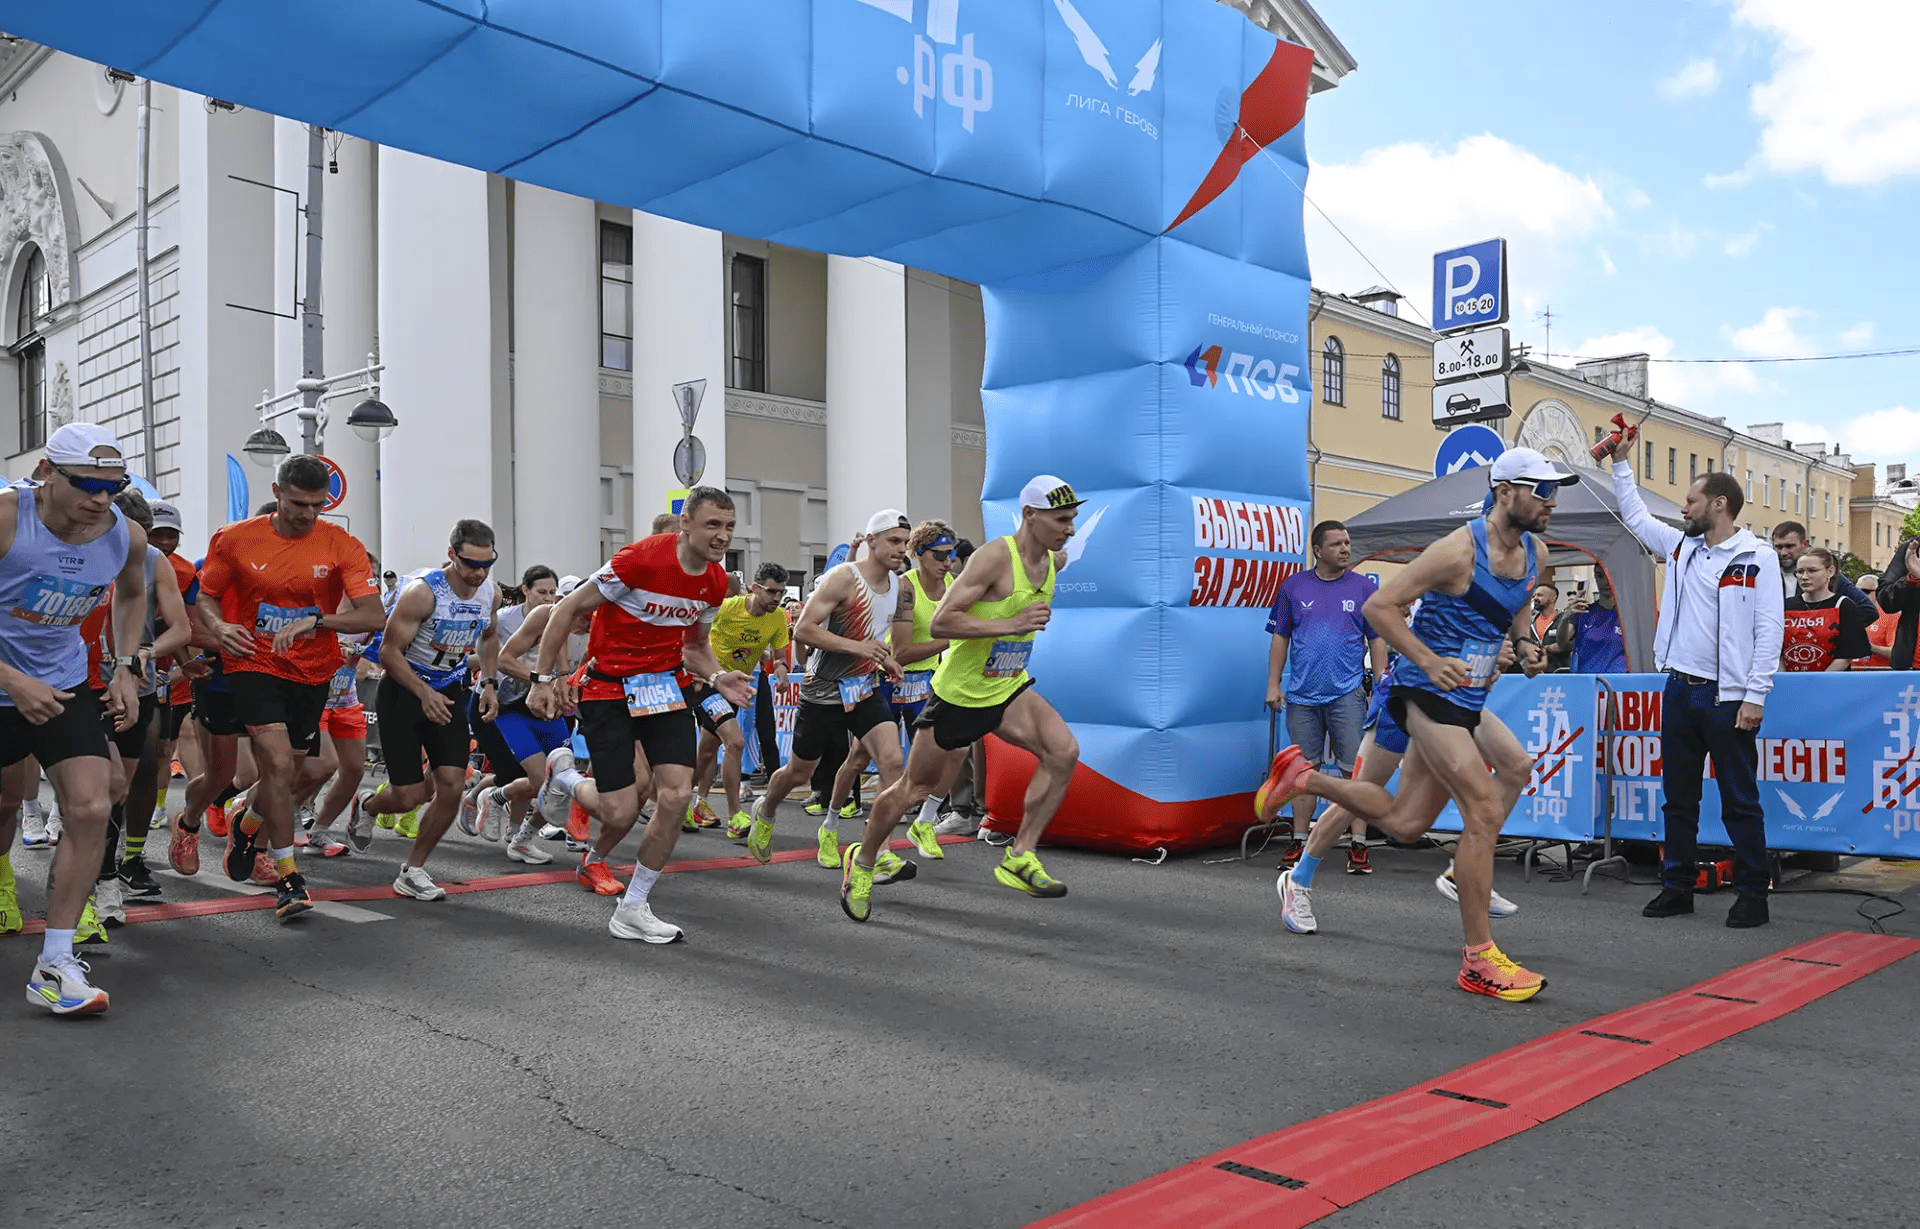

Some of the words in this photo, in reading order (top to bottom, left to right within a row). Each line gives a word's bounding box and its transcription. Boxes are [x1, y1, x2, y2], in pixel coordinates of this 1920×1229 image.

[896, 32, 994, 135] .рф
[1066, 93, 1111, 116] ЛИГА
[1116, 106, 1159, 140] ГЕРОЕВ
[1444, 255, 1481, 321] P
[1456, 304, 1465, 313] 10
[1467, 301, 1477, 311] 15
[1480, 298, 1494, 310] 20
[1208, 313, 1264, 336] ГЕНЕРАЛЬНЫЙ
[1264, 328, 1299, 344] СПОНСОР
[1225, 352, 1300, 404] ПСБ
[1438, 354, 1498, 374] 8.00-18.00
[1191, 496, 1304, 555] ВЫБЕГАЮ
[32, 589, 98, 617] 70188
[1189, 556, 1225, 607] ЗА
[1221, 558, 1304, 608] РАМ
[440, 629, 476, 646] 70234
[632, 683, 676, 707] 70054
[1527, 709, 1574, 755] ЗА
[1756, 739, 1846, 784] ЕСТЕ
[1525, 796, 1568, 824] .рф
[1611, 780, 1661, 821] ЛЕТ
